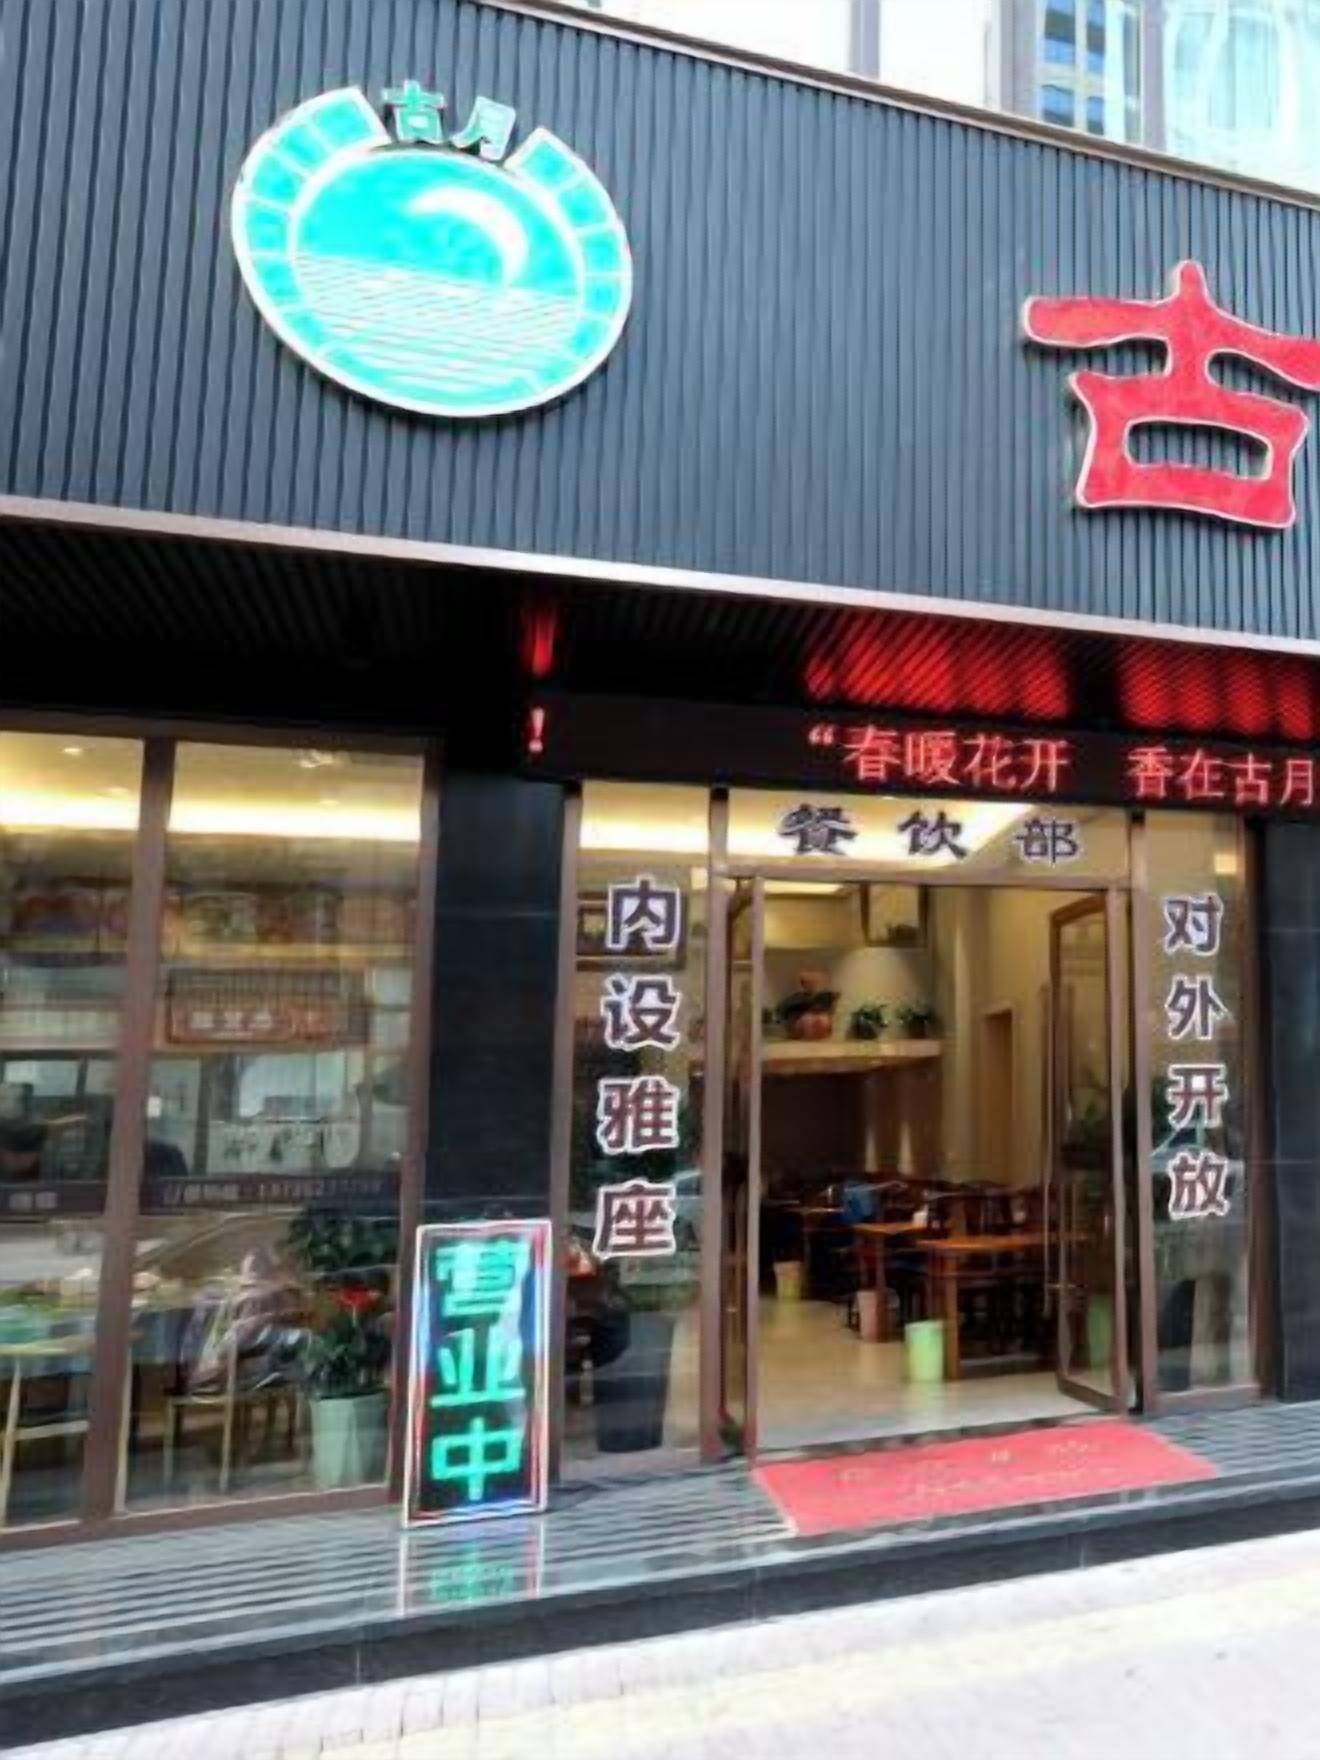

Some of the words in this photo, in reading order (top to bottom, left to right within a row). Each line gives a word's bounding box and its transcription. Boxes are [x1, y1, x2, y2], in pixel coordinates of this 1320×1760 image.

[381, 78, 518, 162] 古月
[778, 802, 1080, 866] 餐饮部
[592, 874, 683, 1262] 内设雅座
[1163, 894, 1232, 1222] 对外开放
[430, 1238, 531, 1502] 营业中
